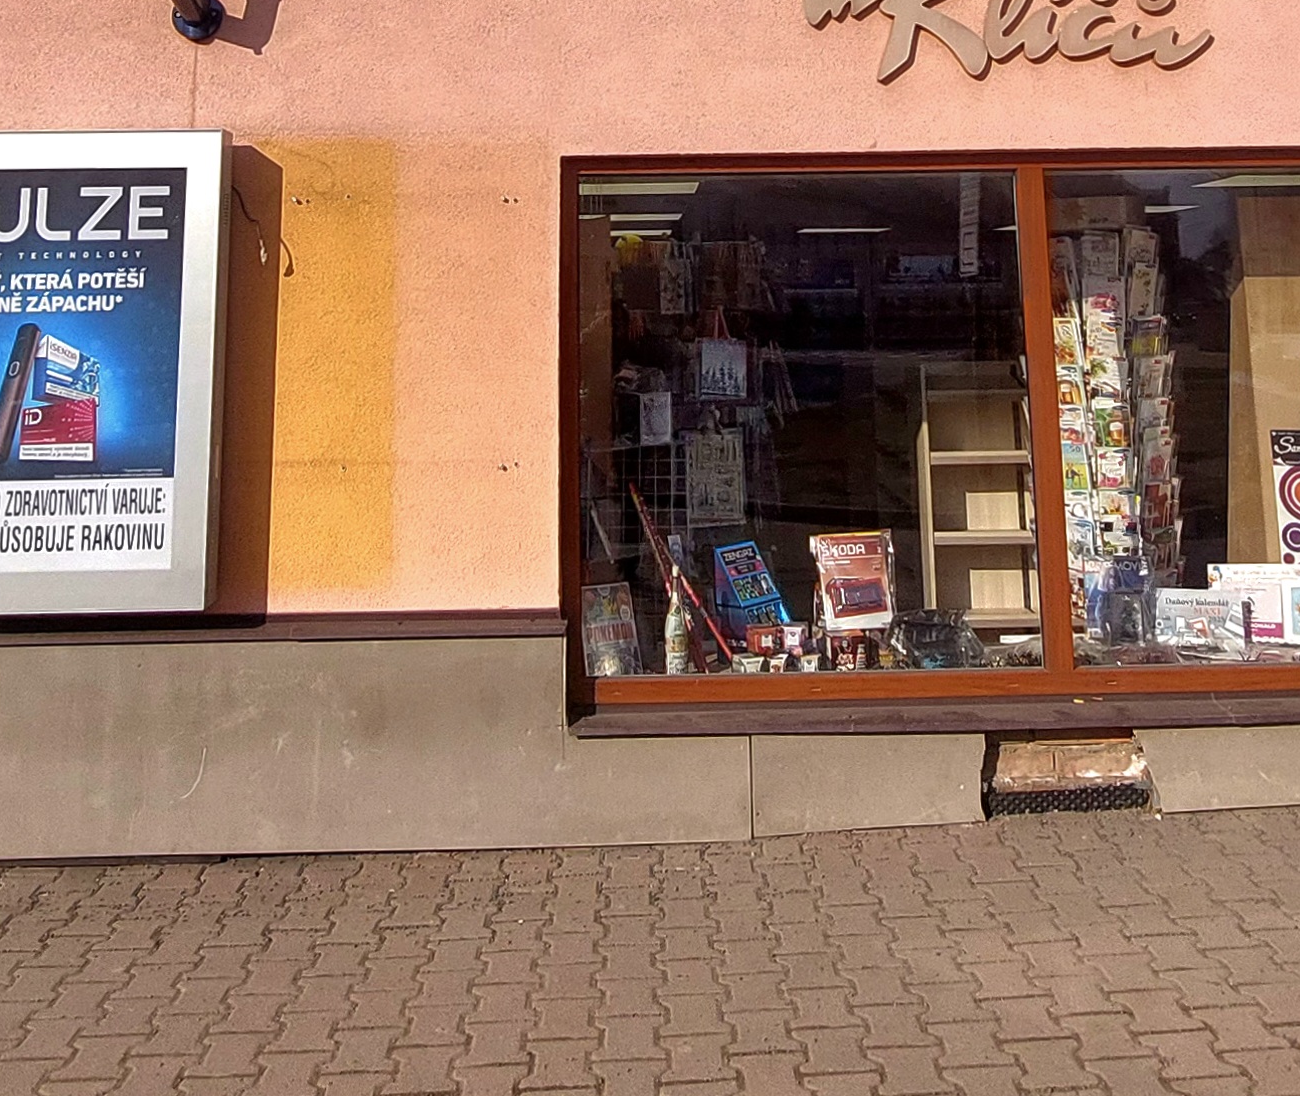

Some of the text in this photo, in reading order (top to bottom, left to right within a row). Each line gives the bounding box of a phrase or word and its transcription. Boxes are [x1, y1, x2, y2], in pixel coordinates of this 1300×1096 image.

[18, 250, 143, 260] TECHNOLOGY
[10, 268, 74, 290] KTERÁ
[77, 266, 148, 289] POTĚŠÍ
[4, 483, 110, 517] ZDRAVOTNICTVÍ
[112, 487, 167, 515] VARUJE:
[80, 522, 166, 552] RAKOVINU
